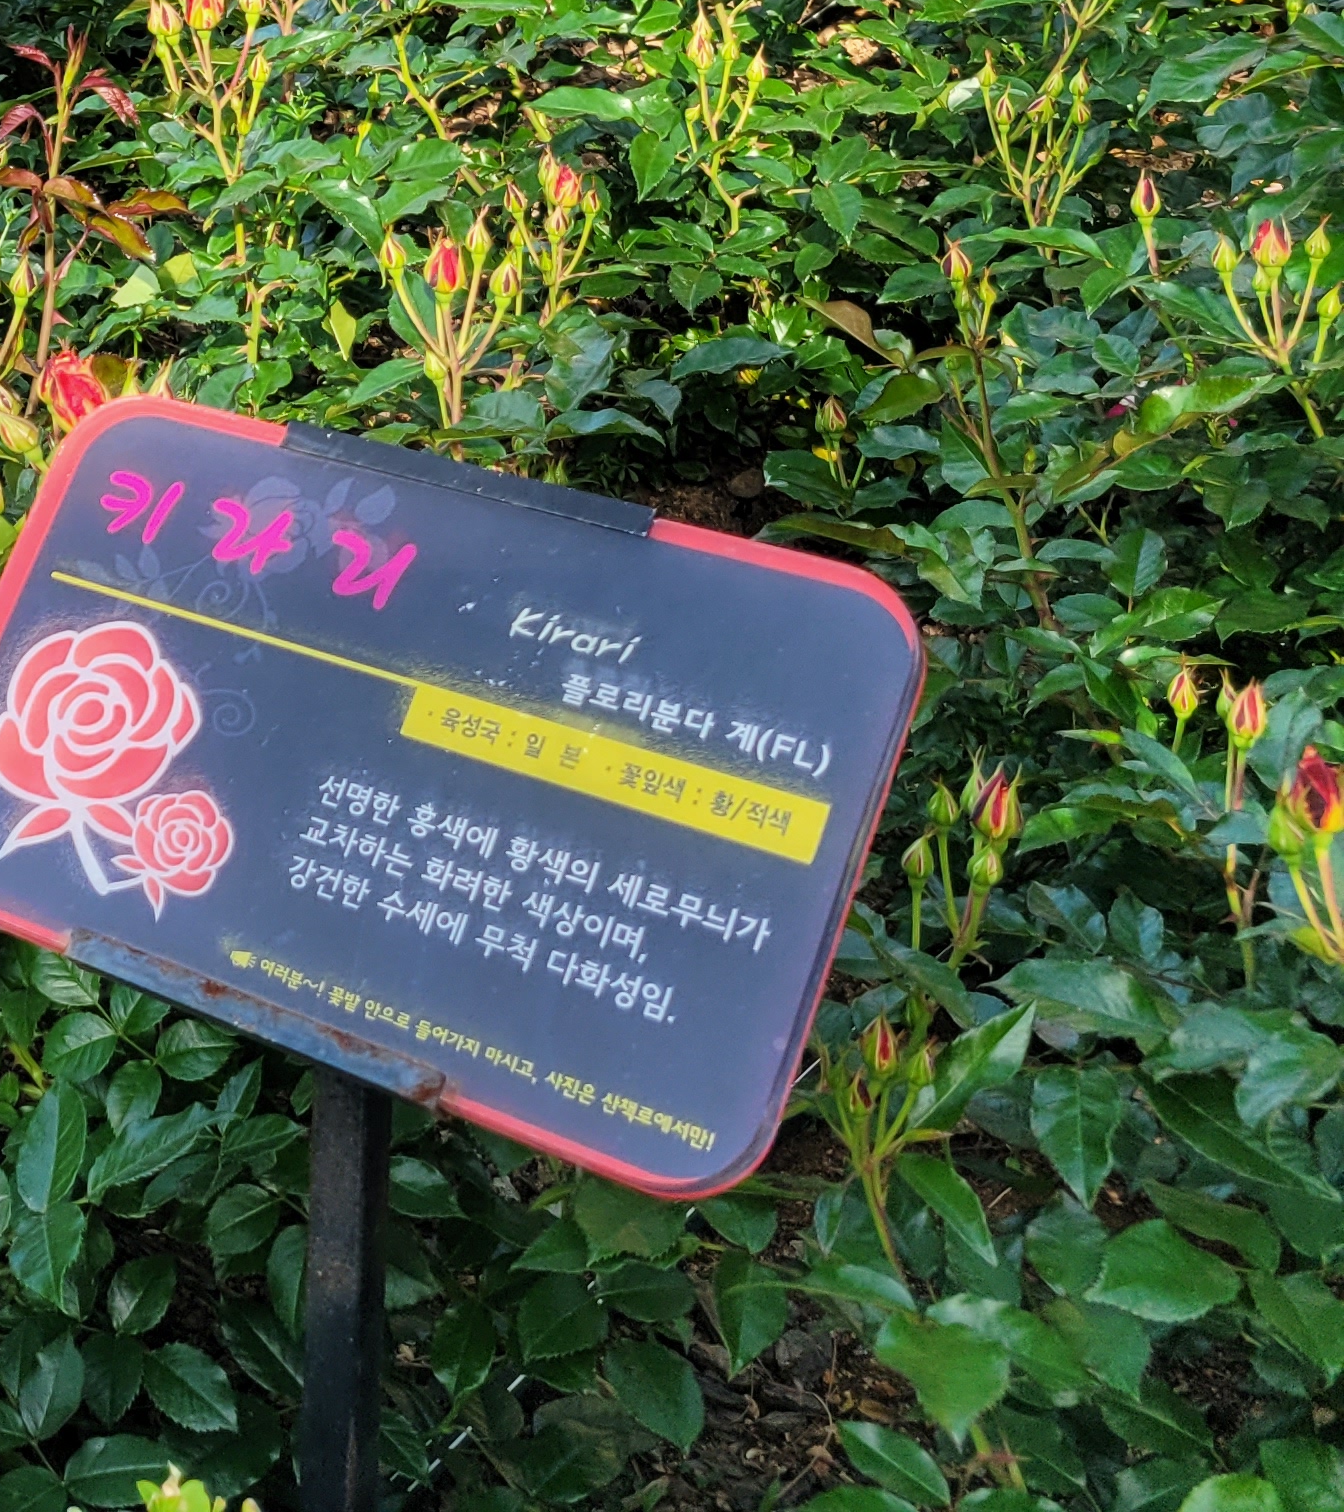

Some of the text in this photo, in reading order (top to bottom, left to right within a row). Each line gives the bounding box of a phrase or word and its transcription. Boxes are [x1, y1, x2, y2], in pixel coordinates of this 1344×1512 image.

[510, 606, 642, 664] Kirari
[439, 706, 502, 745] 육성국
[618, 761, 688, 804] 꽃잎색
[709, 790, 792, 838] 황/적색
[561, 672, 832, 778] 플로리분다 계(FL)
[299, 816, 648, 964] 교차하는 화려한 색상이며,
[318, 775, 772, 954] 선명한 홍색에 황색의 세로무늬가
[288, 855, 677, 1024] 강건한 수세에 무척 다화성임.
[364, 999, 411, 1032] 안으로
[415, 1019, 481, 1059] 들어가지
[484, 1045, 538, 1085] 마시고,
[544, 1070, 596, 1107] 사진은
[601, 1091, 716, 1153] 산책로에서만!
